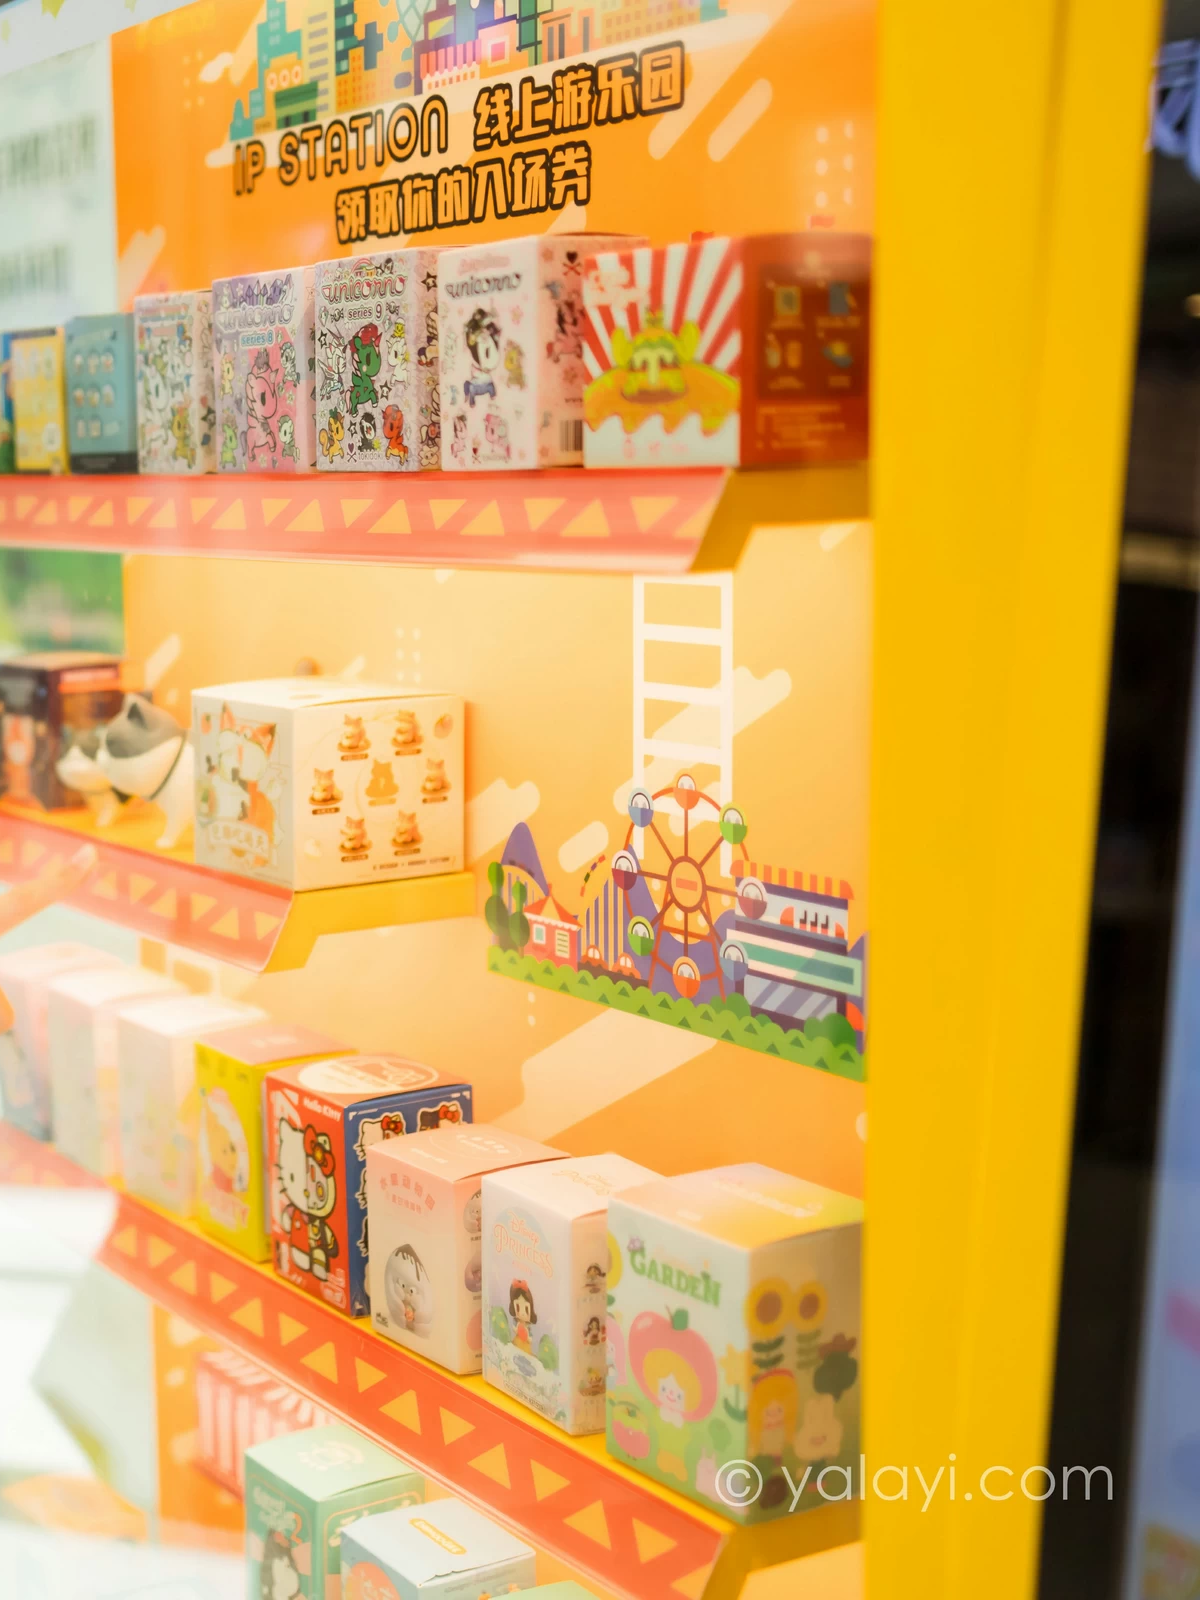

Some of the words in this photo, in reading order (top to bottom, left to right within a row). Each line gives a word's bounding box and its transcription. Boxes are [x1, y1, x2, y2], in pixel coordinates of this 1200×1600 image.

[233, 139, 265, 195] IP
[278, 94, 448, 186] STATION
[473, 40, 686, 151] 线上游乐园
[335, 141, 592, 244] 领取你的入场券
[321, 275, 407, 305] unicorno
[445, 273, 522, 299] unicorno
[348, 308, 372, 319] series
[375, 303, 383, 319] 9
[241, 333, 266, 346] series
[266, 329, 274, 345] 8
[303, 1096, 323, 1113] Hello
